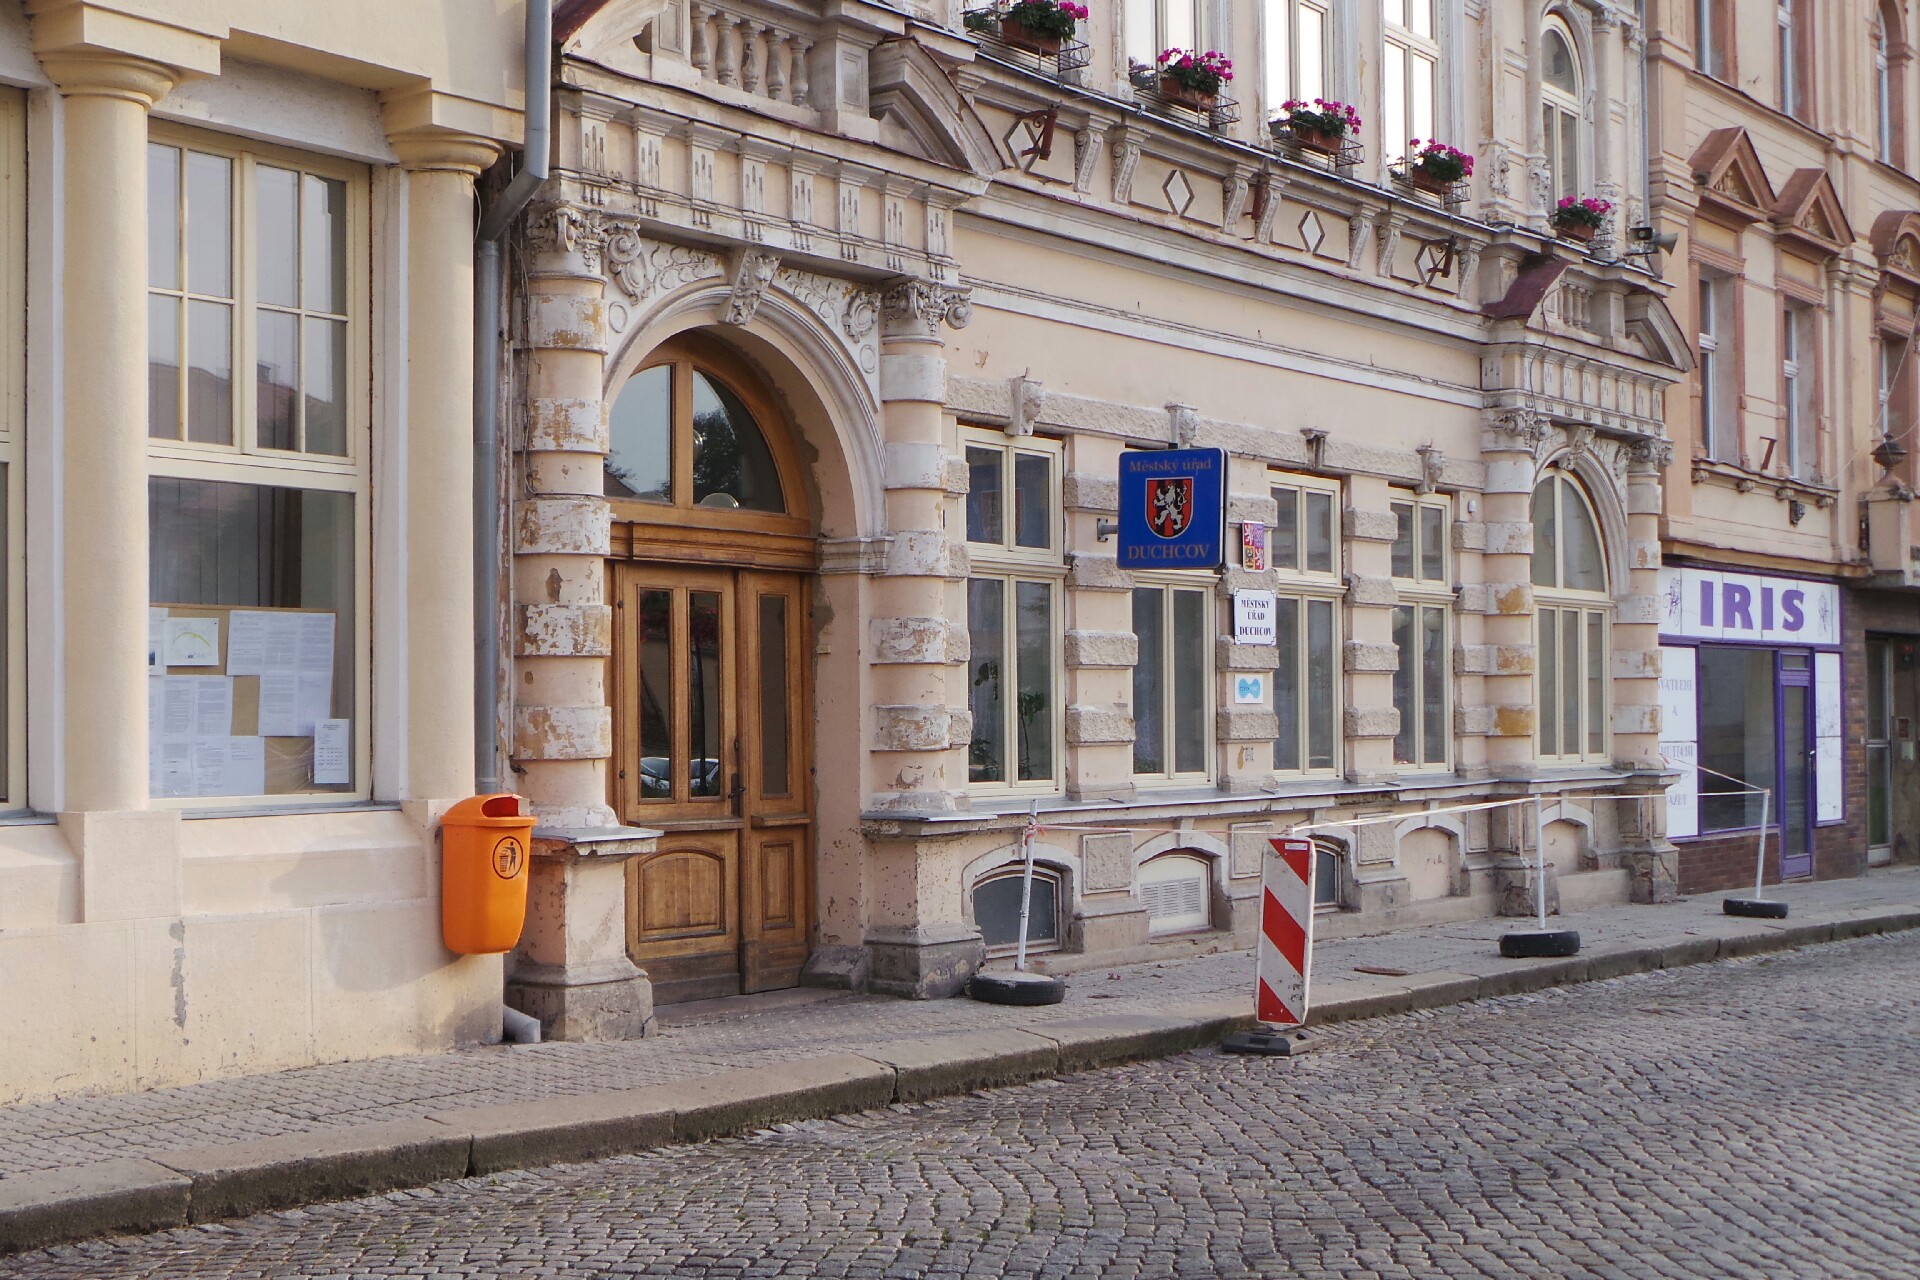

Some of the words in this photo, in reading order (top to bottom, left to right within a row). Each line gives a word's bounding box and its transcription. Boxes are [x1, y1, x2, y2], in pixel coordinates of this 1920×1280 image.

[1129, 459, 1179, 473] Městský
[1127, 544, 1210, 560] DUCHCOV
[1700, 580, 1805, 632] IRIS
[1239, 626, 1272, 636] DUCHCOV
